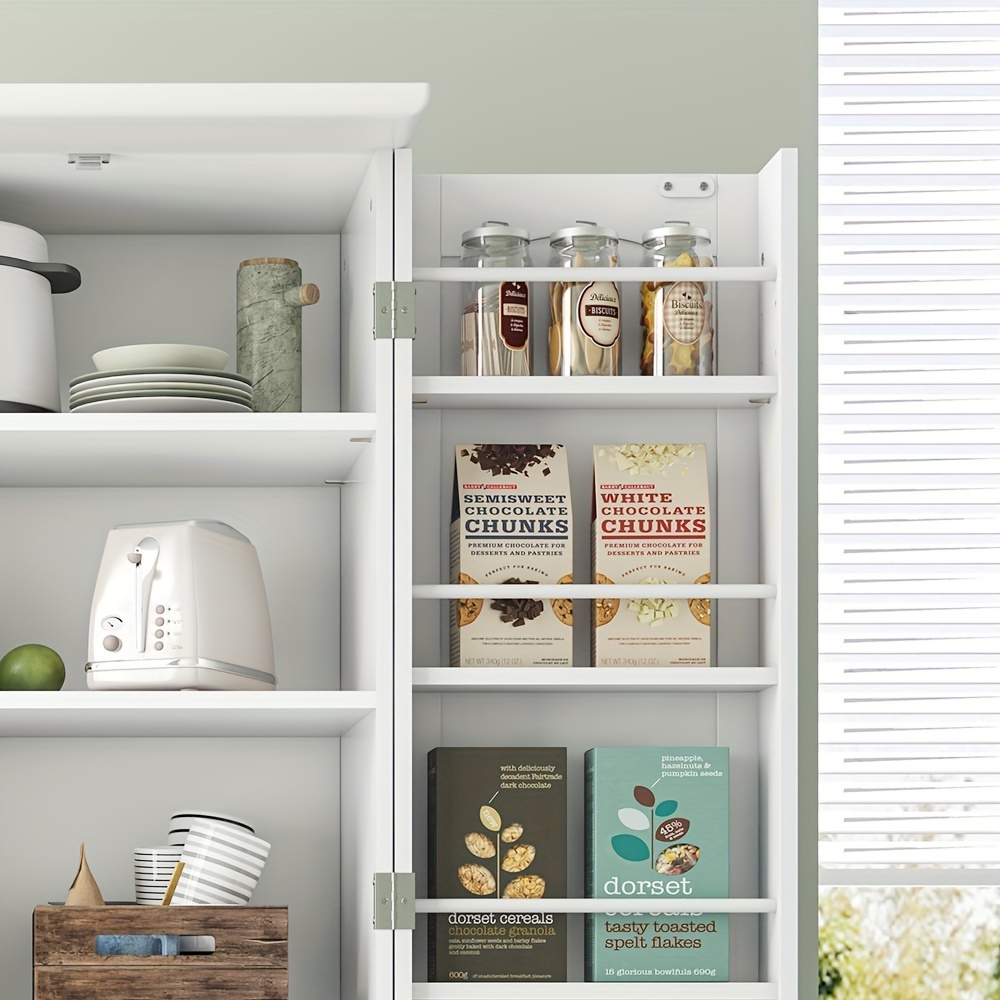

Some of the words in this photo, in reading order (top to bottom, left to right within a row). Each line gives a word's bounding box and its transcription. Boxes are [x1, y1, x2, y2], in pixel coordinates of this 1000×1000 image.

[671, 299, 702, 309] Biscuits
[464, 494, 566, 504] SEMISWEET
[600, 493, 672, 503] WHITE
[465, 507, 568, 516] CHOCOLATE
[601, 506, 706, 516] CHOCOLATE
[465, 519, 569, 534] CHUNKS
[601, 519, 706, 534] CHUNKS
[518, 765, 556, 773] deliciously
[661, 770, 699, 778] pumpkin
[603, 877, 693, 895] dorset
[448, 912, 497, 925] dorset
[499, 912, 554, 925] cereals
[448, 925, 506, 936] chocolate
[508, 925, 556, 938] granola
[605, 921, 649, 935] tasty
[653, 920, 717, 933] toasted
[605, 936, 648, 951] spelt
[651, 936, 702, 949] flakes
[448, 971, 469, 980] 600g
[616, 968, 653, 976] glorious
